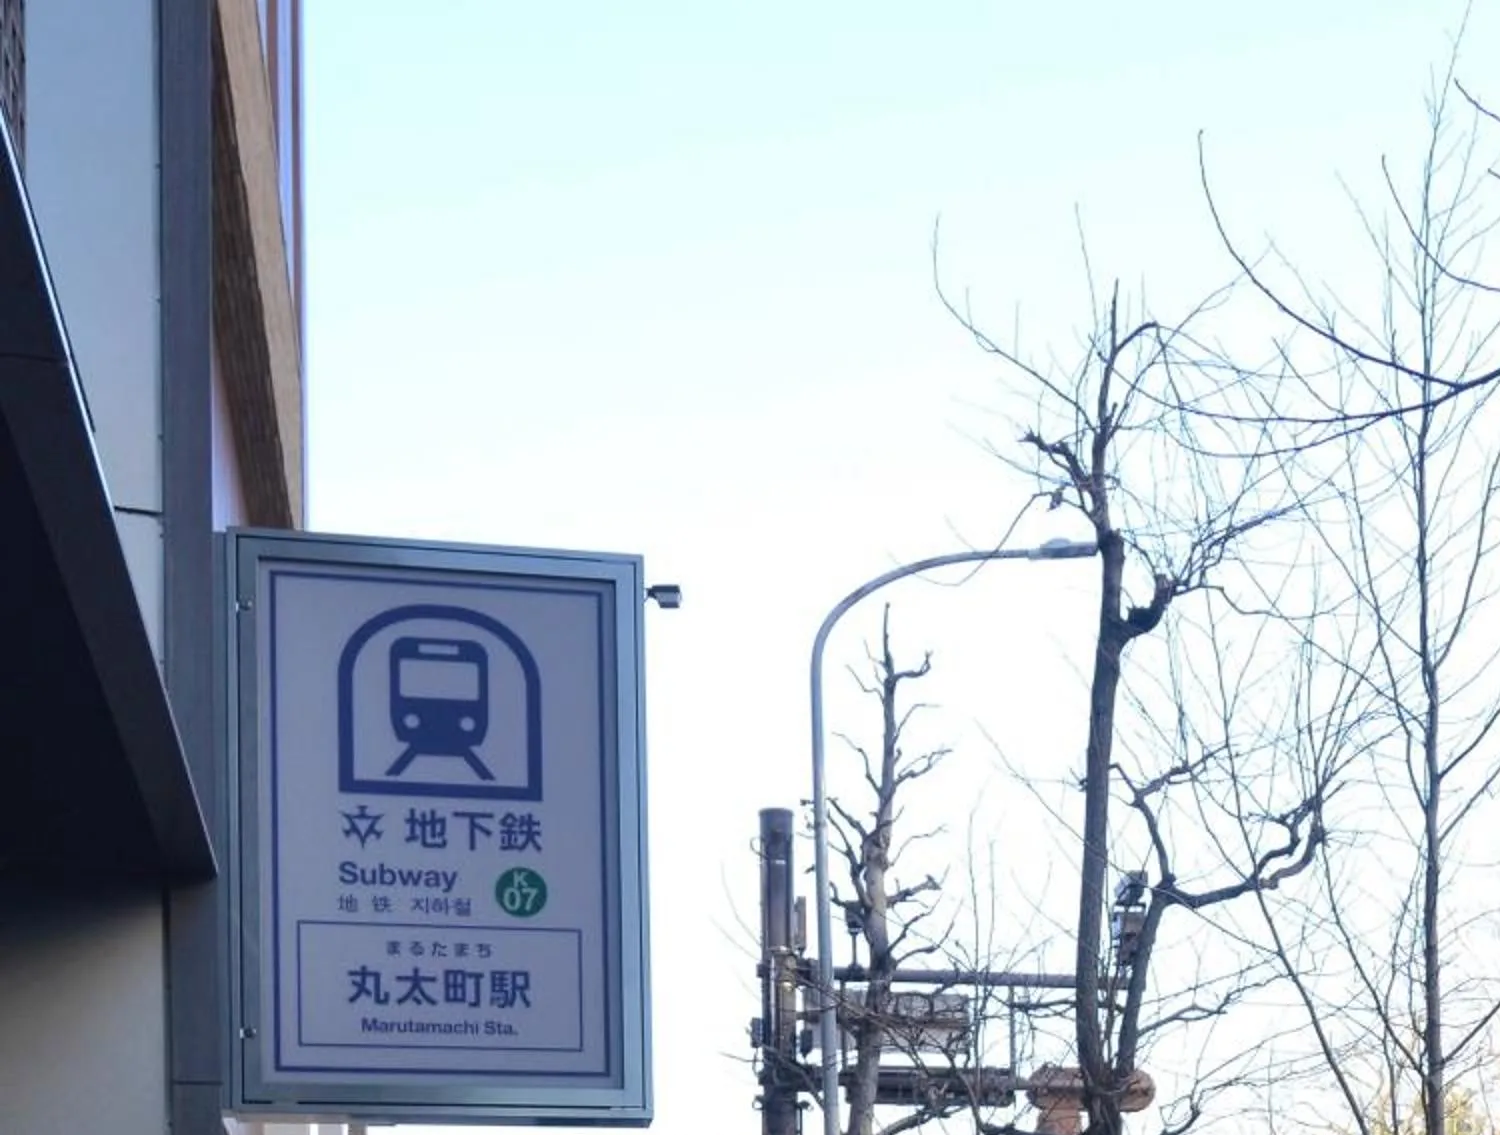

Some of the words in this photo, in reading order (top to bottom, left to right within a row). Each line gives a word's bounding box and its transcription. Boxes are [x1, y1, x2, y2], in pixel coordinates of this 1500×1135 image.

[404, 807, 542, 851] 地下鉄
[338, 860, 457, 892] Subway
[512, 871, 528, 887] K
[503, 888, 539, 911] 07
[386, 940, 492, 958] まるたまち
[347, 965, 531, 1008] 丸太町駅
[361, 1017, 479, 1035] Marutamachi
[483, 1020, 518, 1036] Sta.
